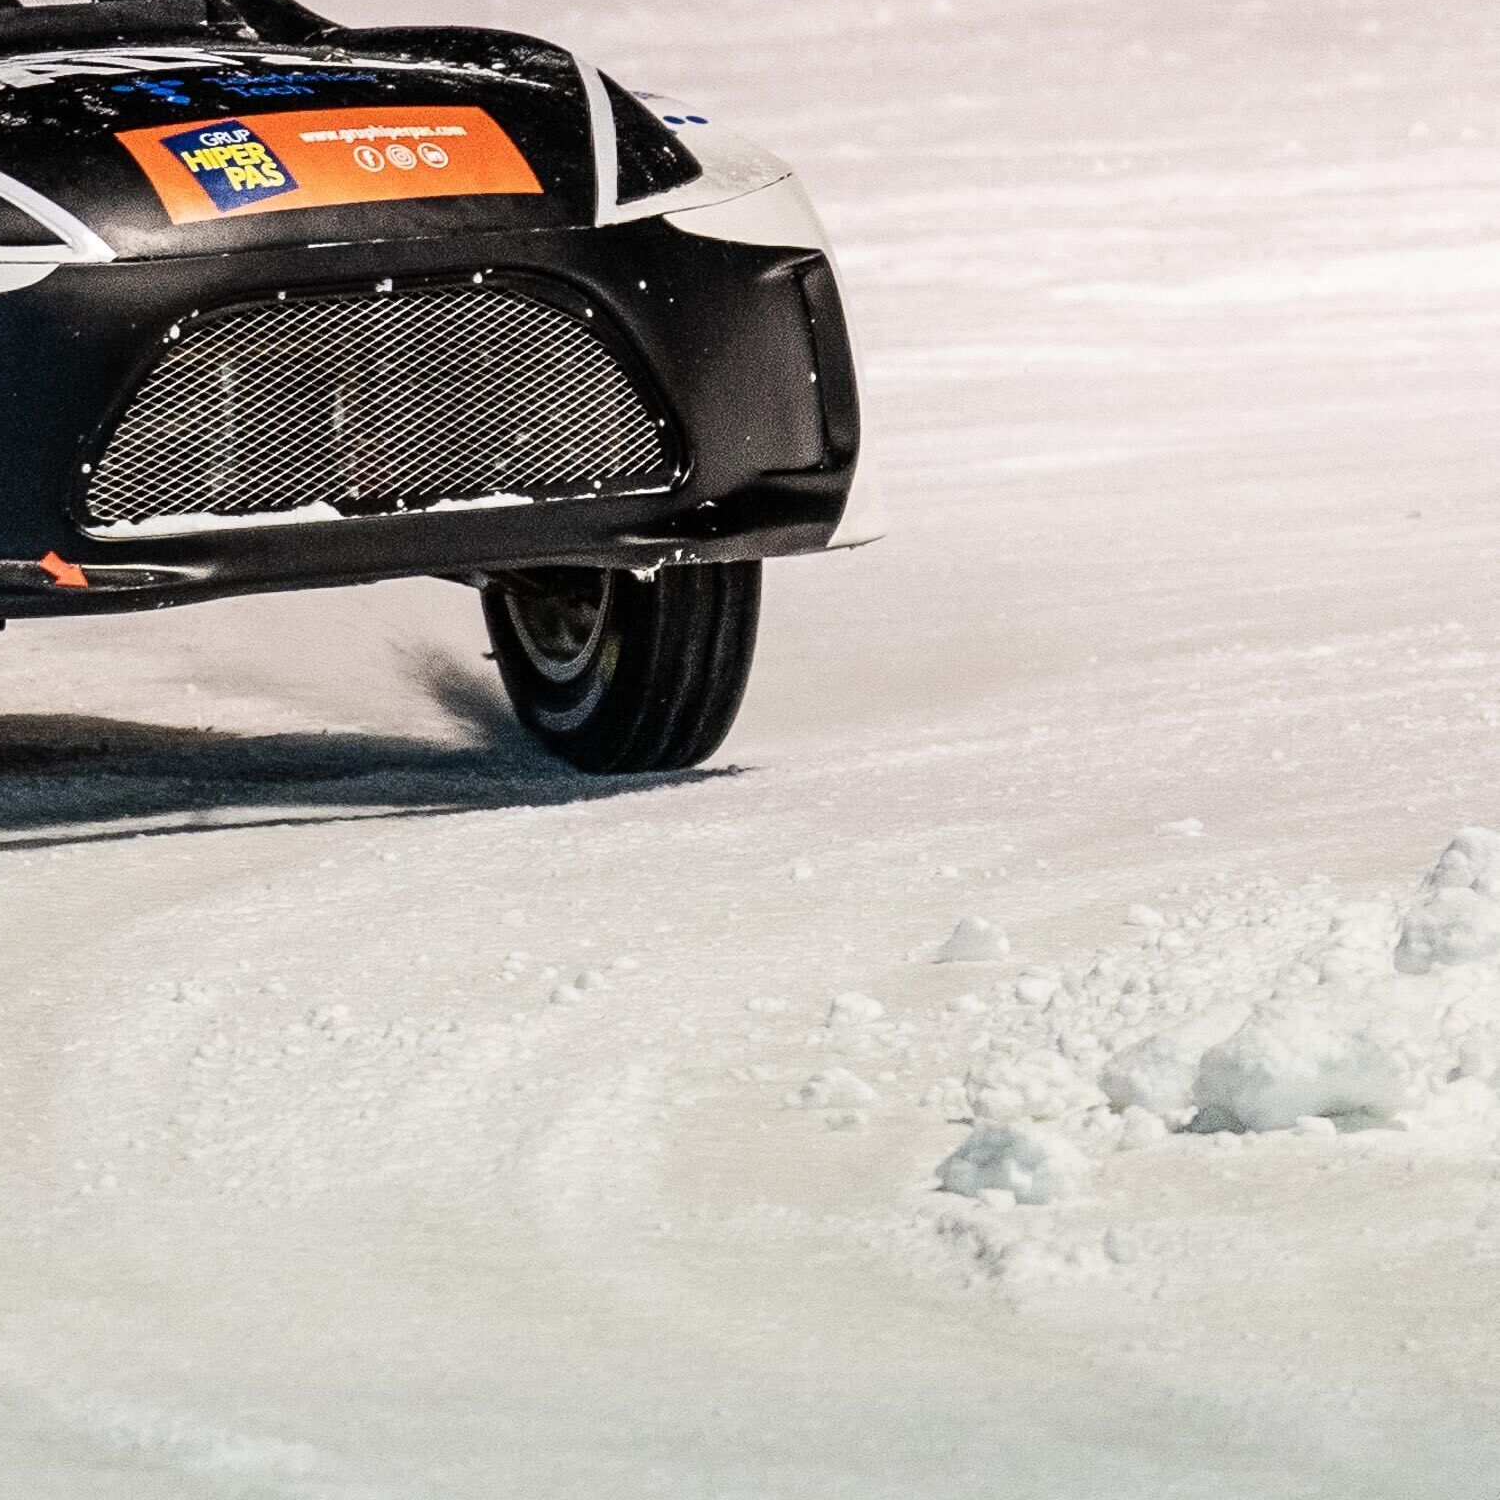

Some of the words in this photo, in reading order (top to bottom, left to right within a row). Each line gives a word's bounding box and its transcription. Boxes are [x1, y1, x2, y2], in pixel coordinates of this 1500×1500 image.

[199, 129, 250, 146] GRUP
[180, 142, 272, 173] HIPER
[224, 161, 286, 192] PAS
